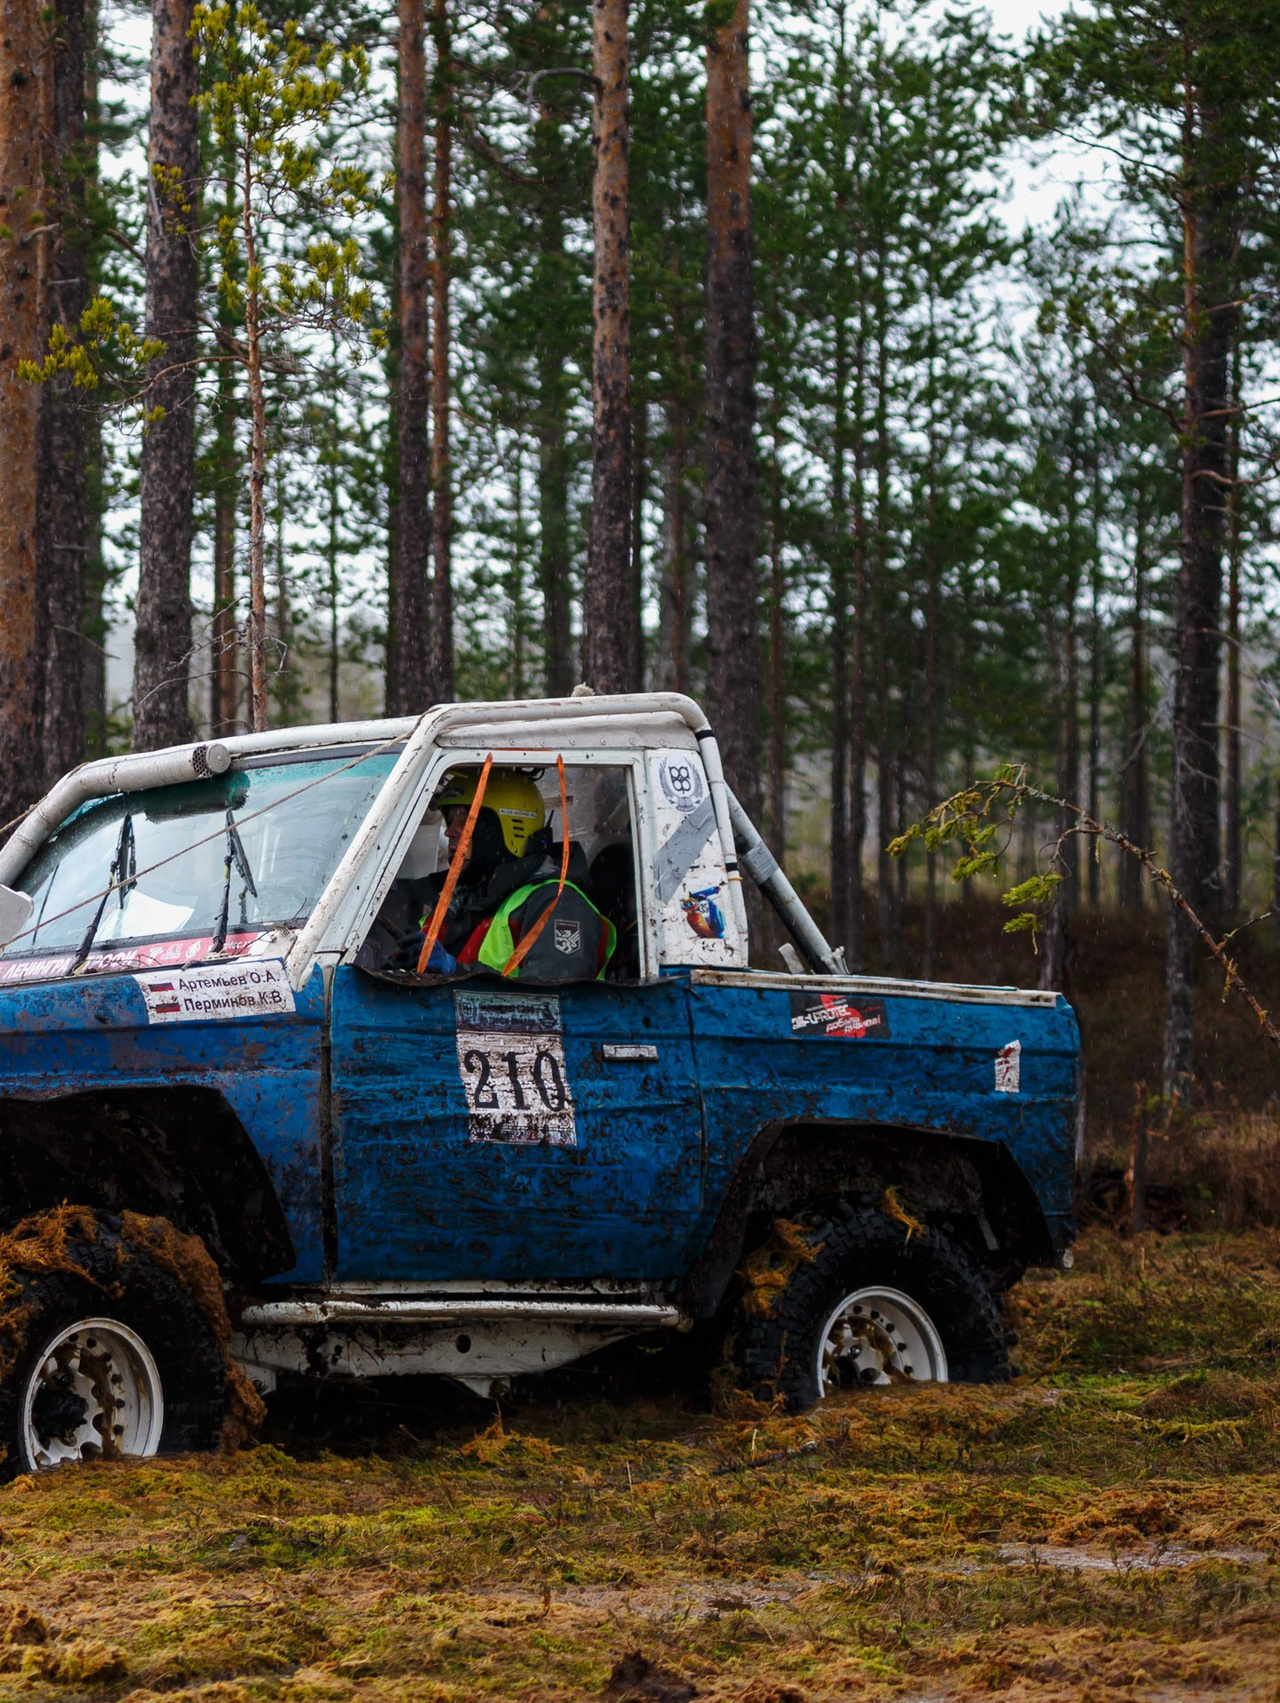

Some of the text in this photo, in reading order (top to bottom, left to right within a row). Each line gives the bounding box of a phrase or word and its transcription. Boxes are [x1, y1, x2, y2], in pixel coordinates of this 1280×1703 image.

[2, 957, 73, 980] ЛЕНИНГРА
[179, 970, 280, 992] Артемьев О.А.
[184, 995, 256, 1012] Перминов
[464, 1049, 566, 1112] 210
